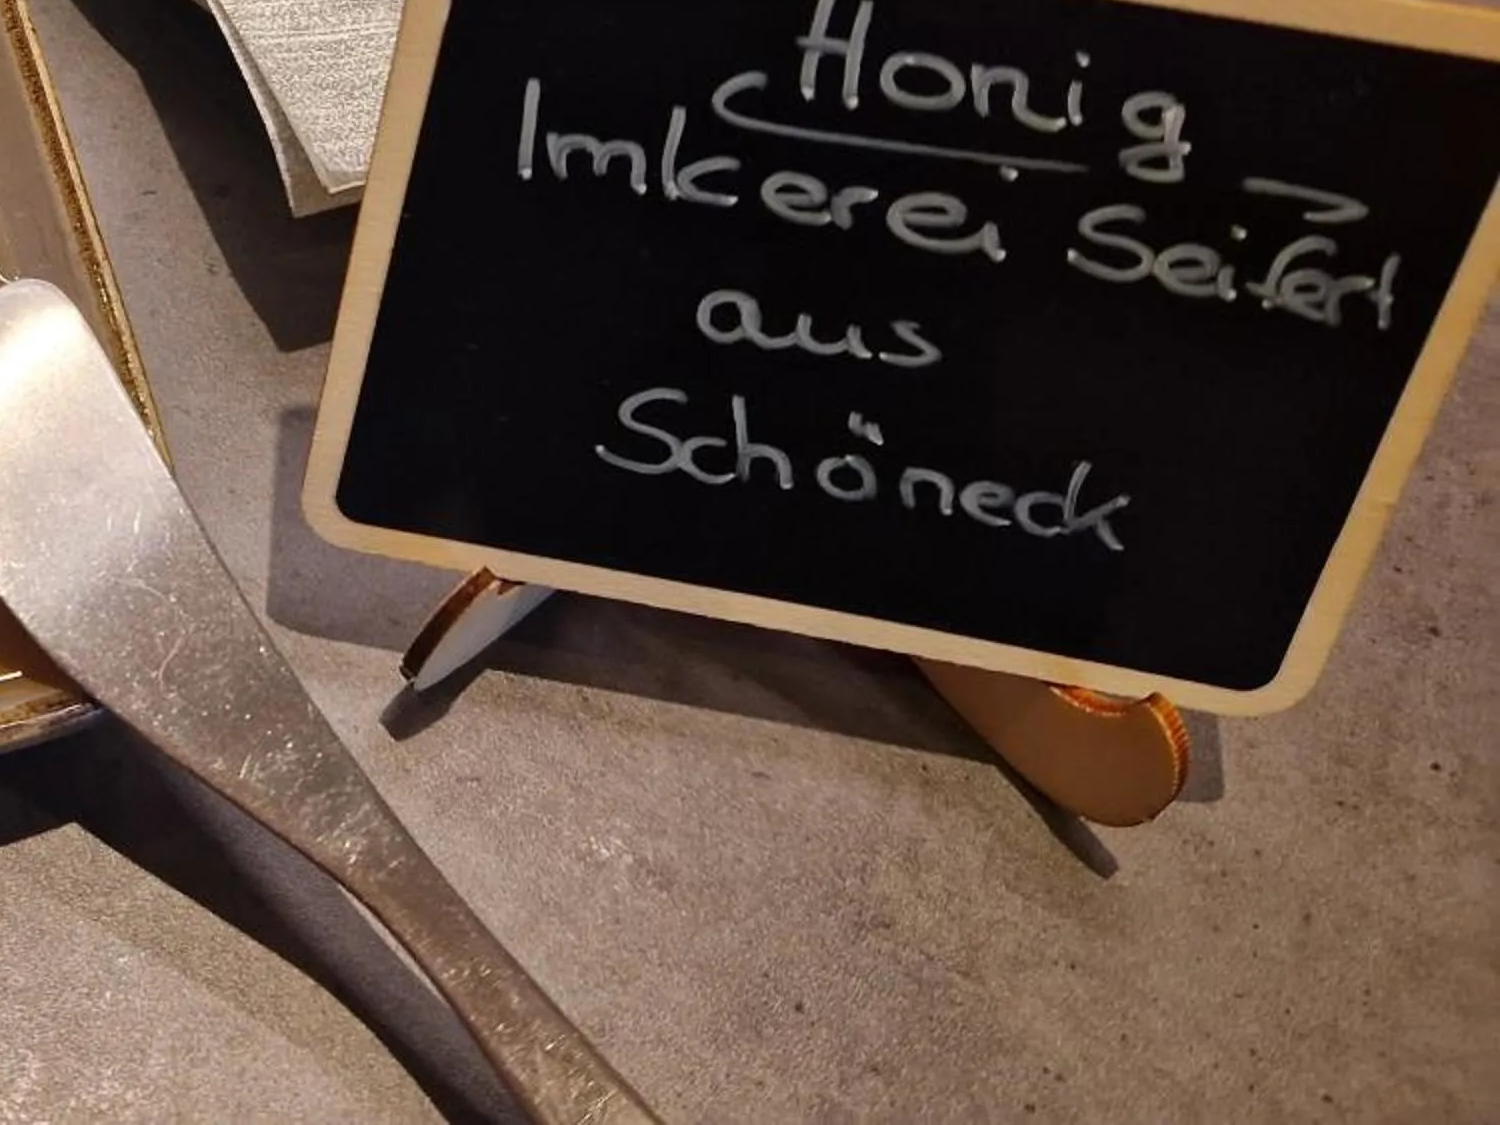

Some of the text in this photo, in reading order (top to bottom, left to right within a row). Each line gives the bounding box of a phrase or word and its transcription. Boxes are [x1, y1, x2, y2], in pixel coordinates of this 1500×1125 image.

[516, 76, 1400, 330] Imkerei Seifert
[696, 287, 942, 368] aus
[594, 385, 1131, 552] Schöneck
